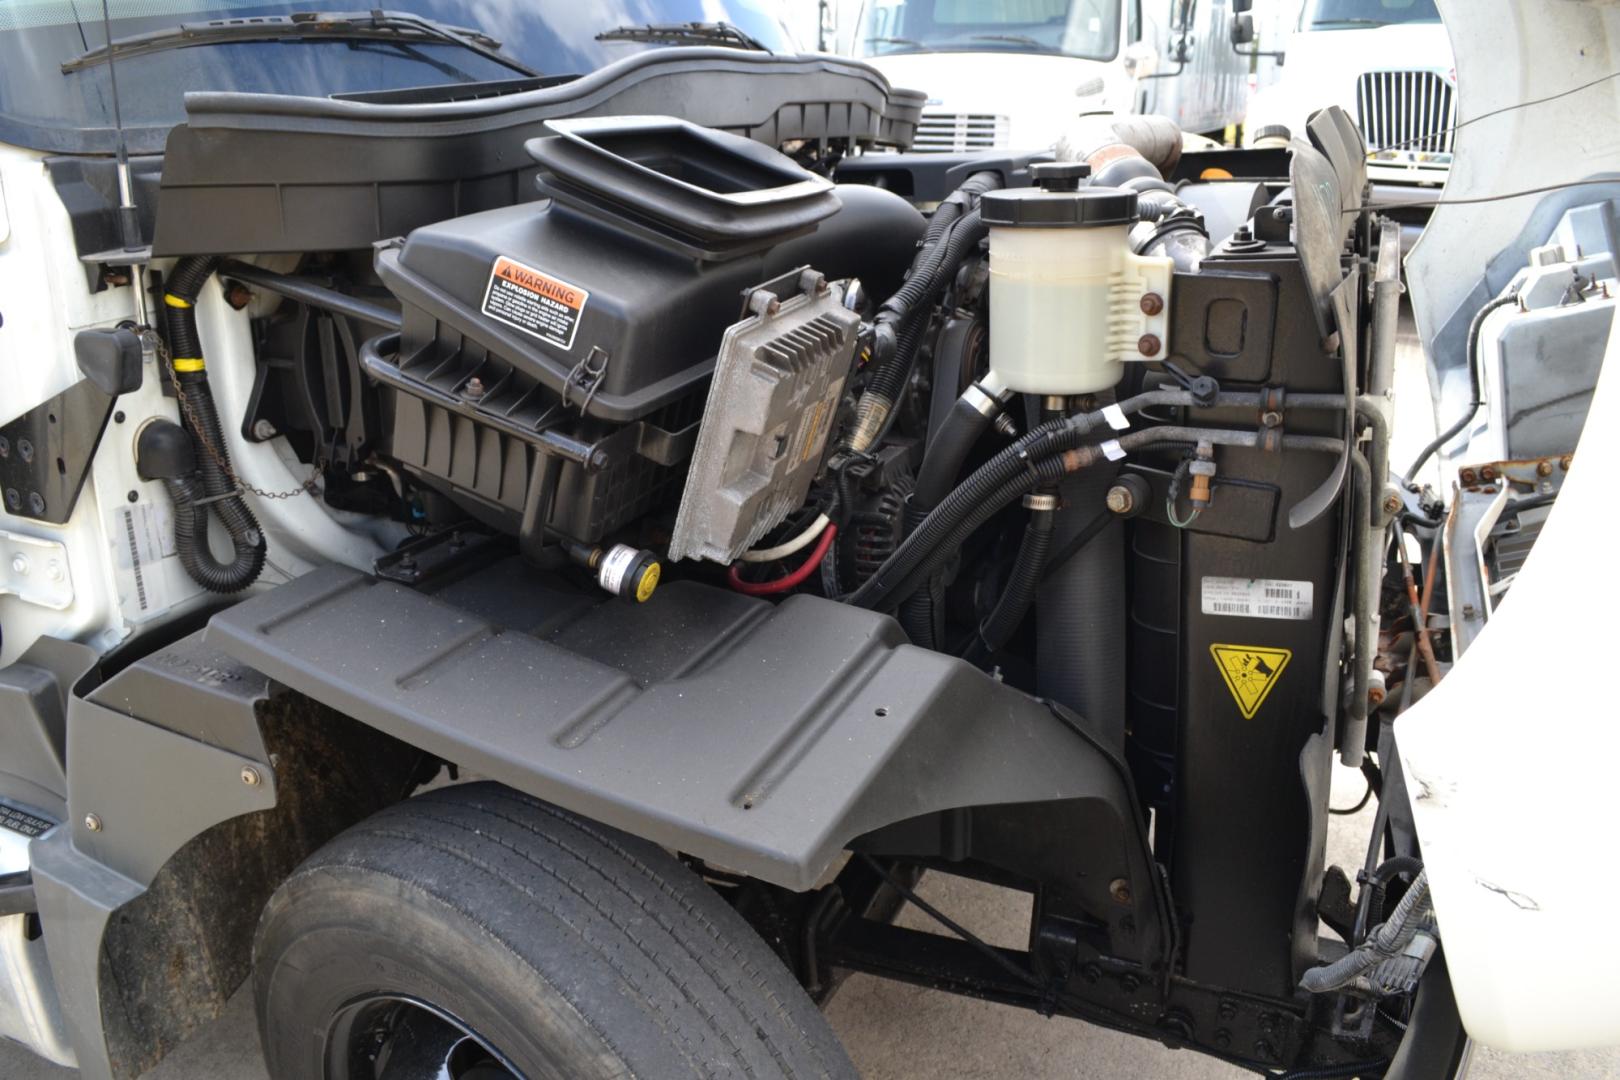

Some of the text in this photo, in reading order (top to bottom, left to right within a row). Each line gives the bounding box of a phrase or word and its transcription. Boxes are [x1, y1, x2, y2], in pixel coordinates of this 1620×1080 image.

[502, 280, 568, 313] EXPLOSION HAZARD
[514, 269, 575, 303] WARNING
